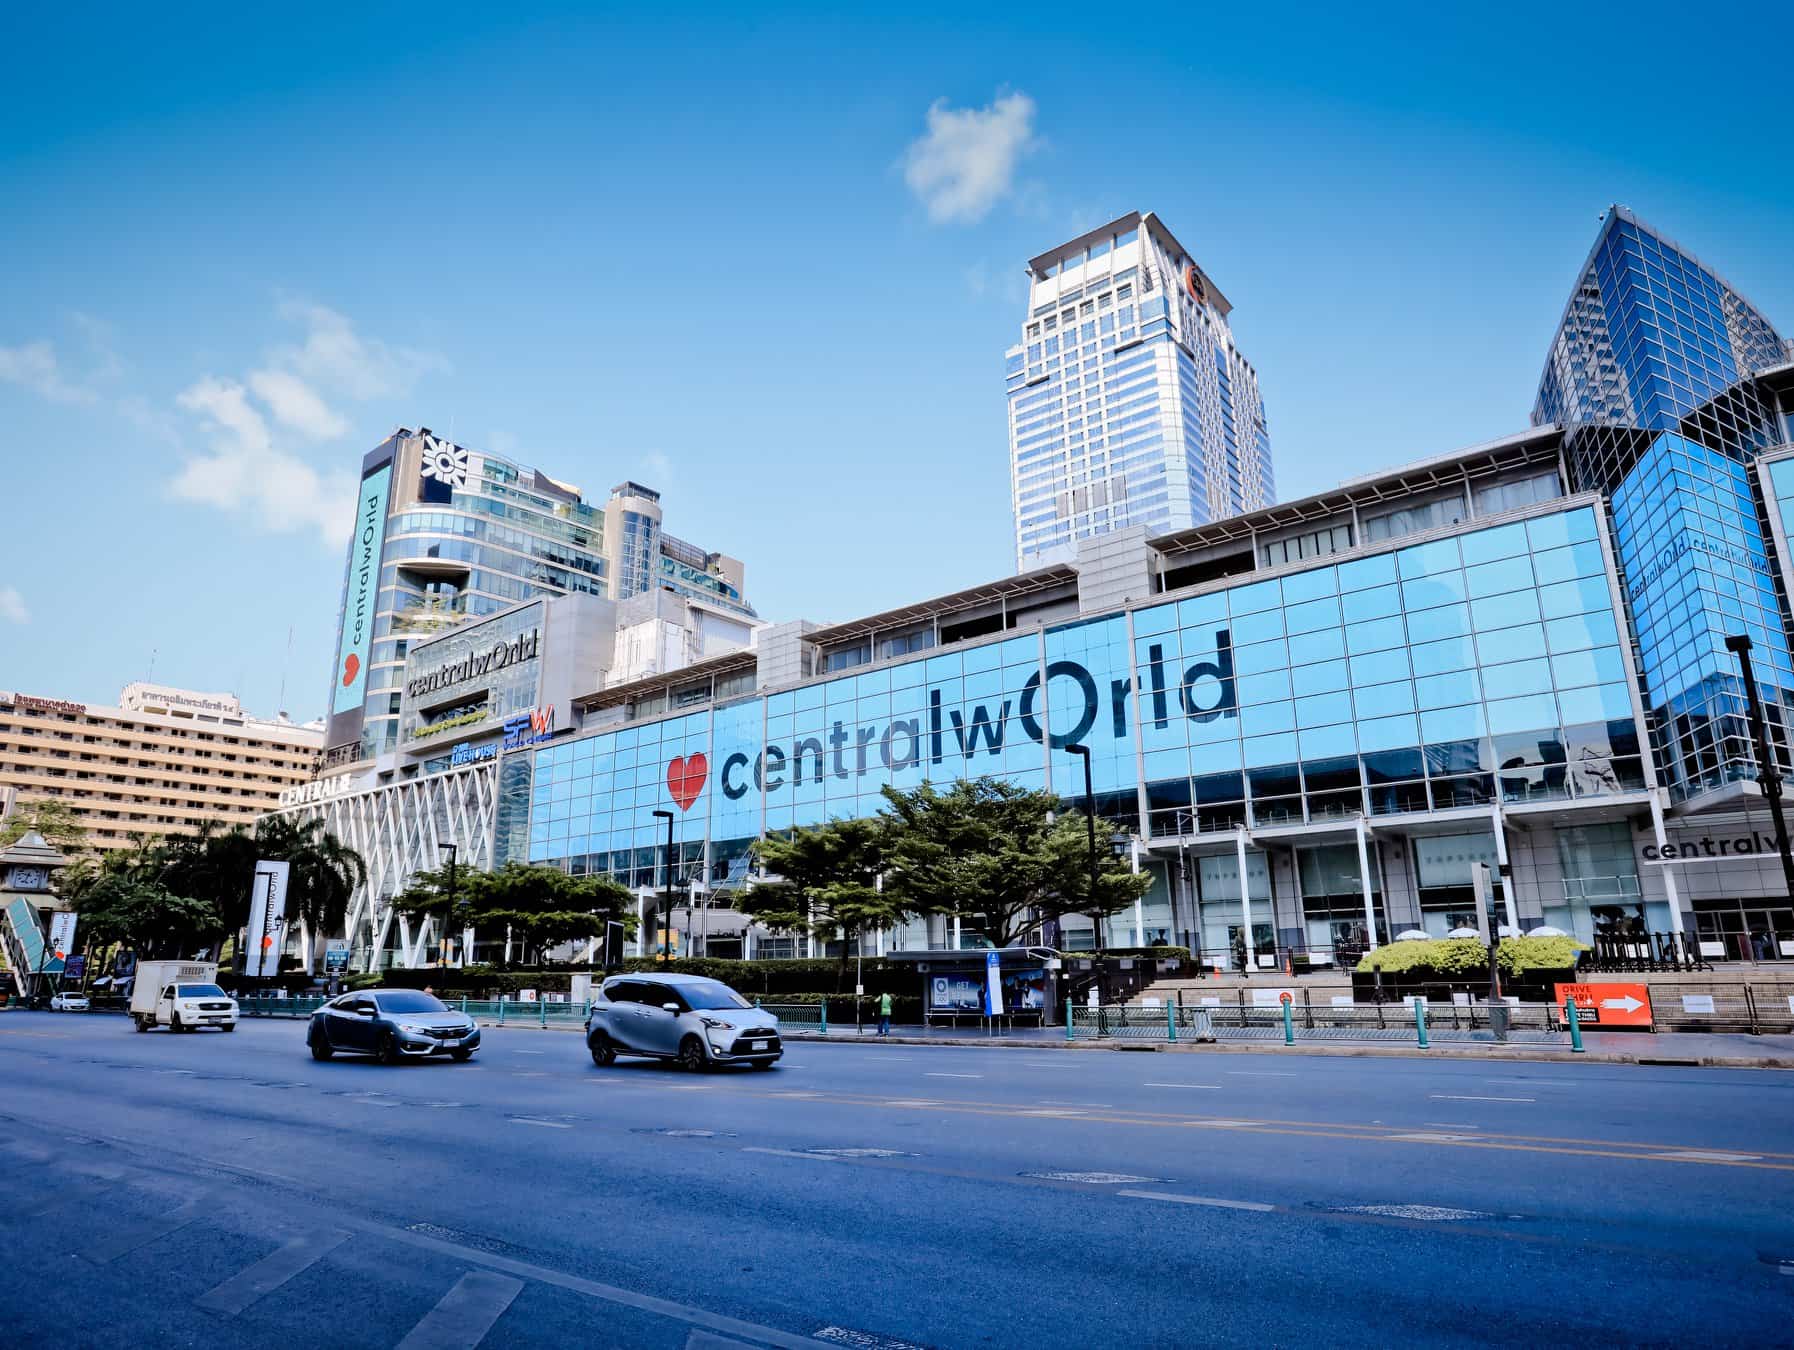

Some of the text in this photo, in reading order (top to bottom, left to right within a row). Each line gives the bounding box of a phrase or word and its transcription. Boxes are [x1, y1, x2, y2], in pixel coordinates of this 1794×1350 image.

[354, 495, 379, 645] centralwOrld
[407, 628, 538, 698] centralwOrld
[720, 630, 1238, 800] centralwOrld
[1562, 985, 1592, 993] DRIVE
